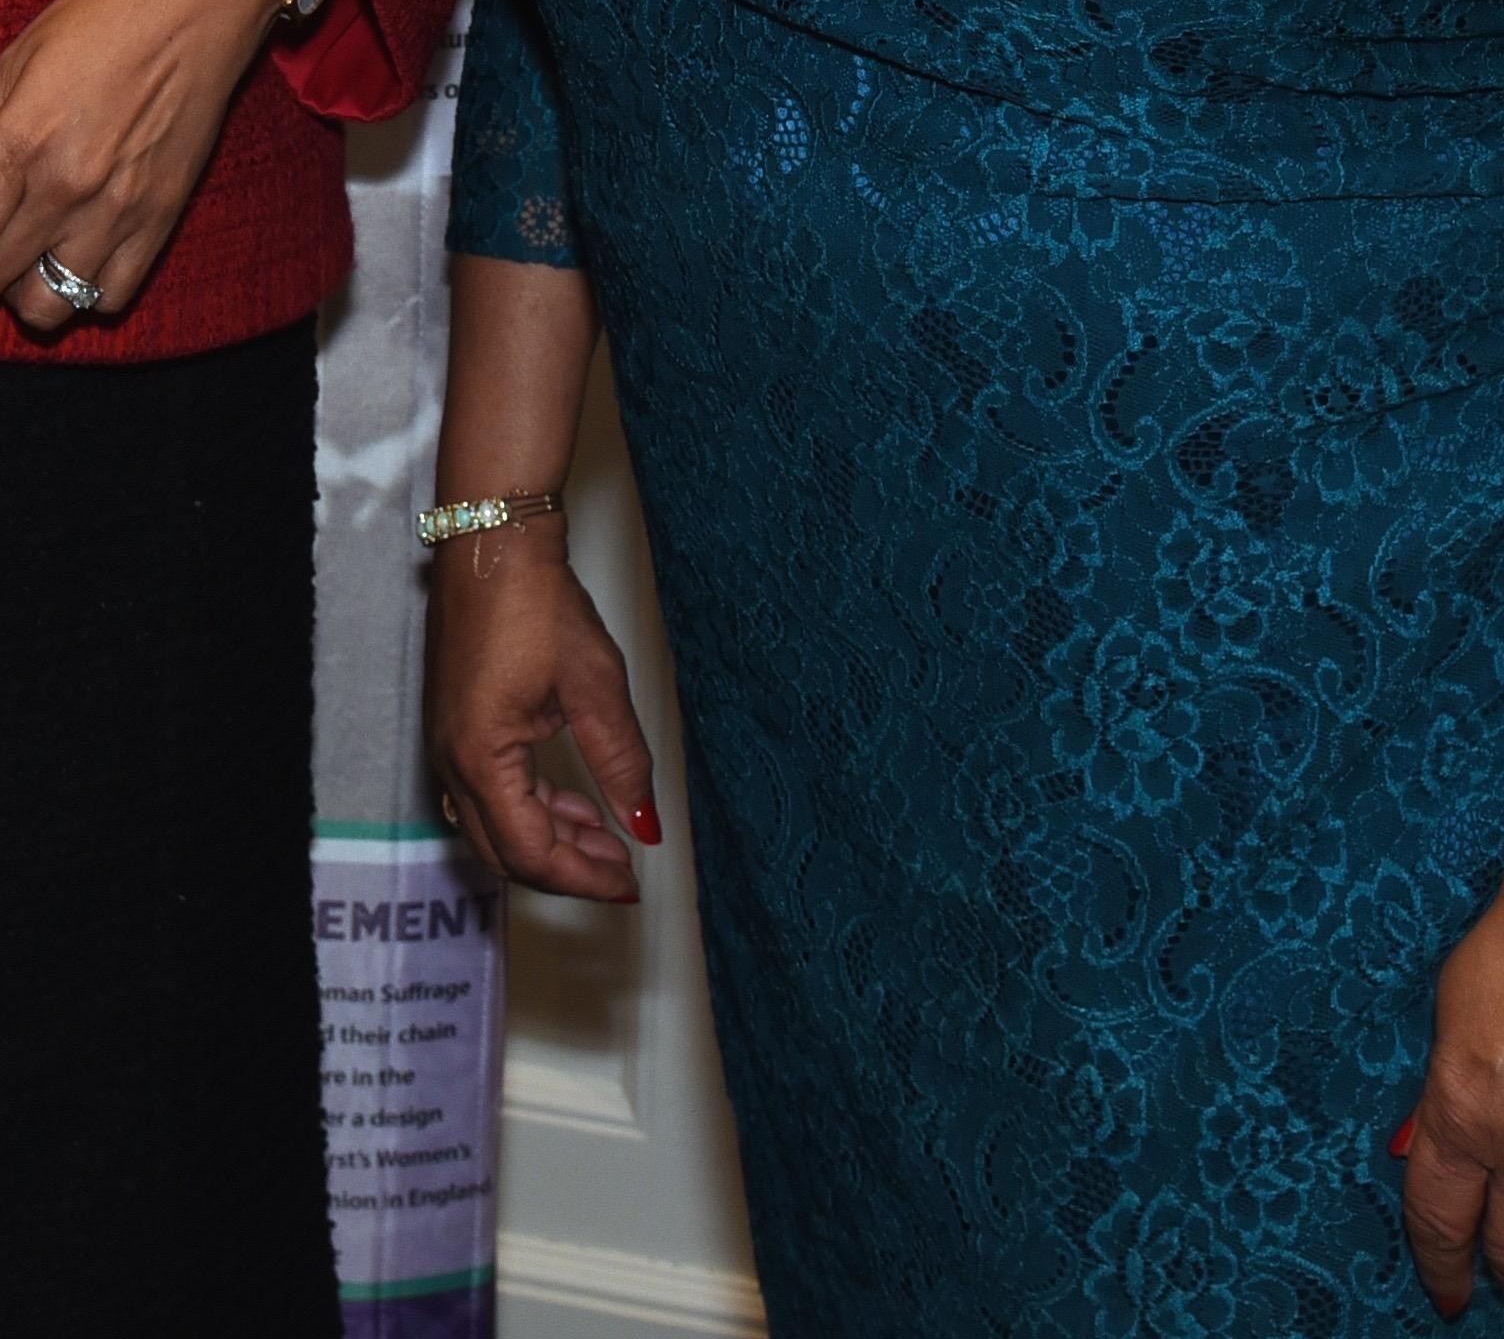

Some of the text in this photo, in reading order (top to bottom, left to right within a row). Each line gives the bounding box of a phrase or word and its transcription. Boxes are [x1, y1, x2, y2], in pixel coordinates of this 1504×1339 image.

[316, 896, 498, 942] EMENT
[381, 980, 472, 1005] Suffrage
[340, 1025, 391, 1045] their
[398, 1022, 457, 1044] chain
[351, 1067, 374, 1086] in
[380, 1066, 416, 1085] the
[351, 1112, 365, 1127] a
[370, 1106, 444, 1130] design
[408, 1176, 494, 1208] England
